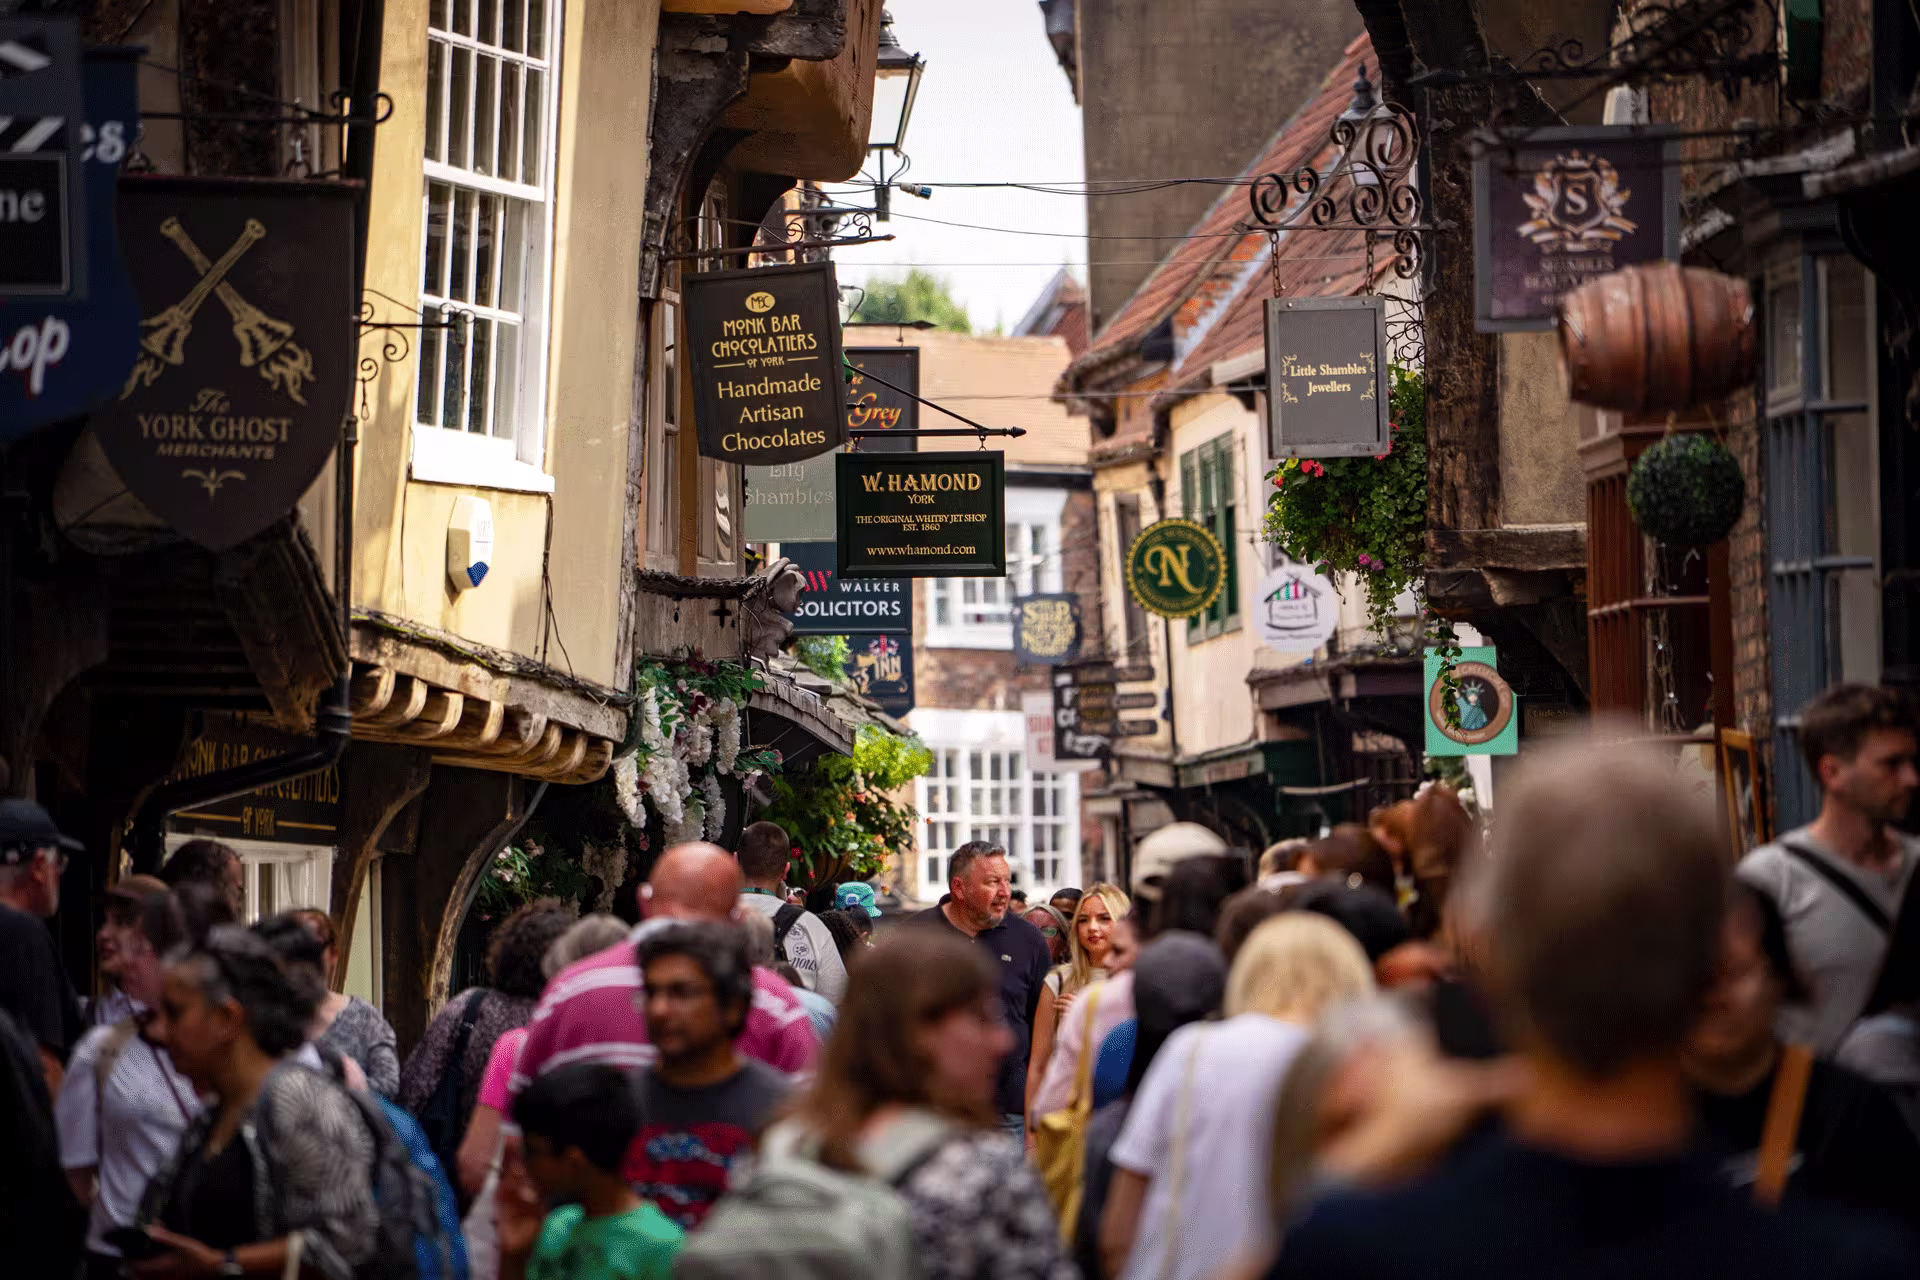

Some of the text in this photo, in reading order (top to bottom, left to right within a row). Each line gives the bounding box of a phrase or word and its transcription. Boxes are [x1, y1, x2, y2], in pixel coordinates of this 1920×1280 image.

[723, 314, 801, 337] MONK BAR
[711, 333, 817, 358] CHOCOLATIERS
[0, 315, 70, 394] op
[746, 356, 785, 369] OF YORK
[1290, 363, 1367, 377] Little Shambles
[717, 373, 821, 399] Handmade
[1306, 380, 1351, 397] Jewellers
[739, 404, 804, 424] Artisan
[137, 414, 292, 443] YORK GHOST
[721, 428, 826, 452] Chocolates
[861, 471, 982, 492] W. HAMOND
[745, 488, 834, 505] Shambles
[907, 494, 935, 504] YORK
[855, 513, 987, 524] THE ORIGINAL WHITBY JET SHOP
[902, 523, 941, 532] EST. 1860
[866, 544, 976, 556] www.whamond.com
[840, 582, 901, 593] WALKER
[794, 601, 901, 617] SOLICITORS
